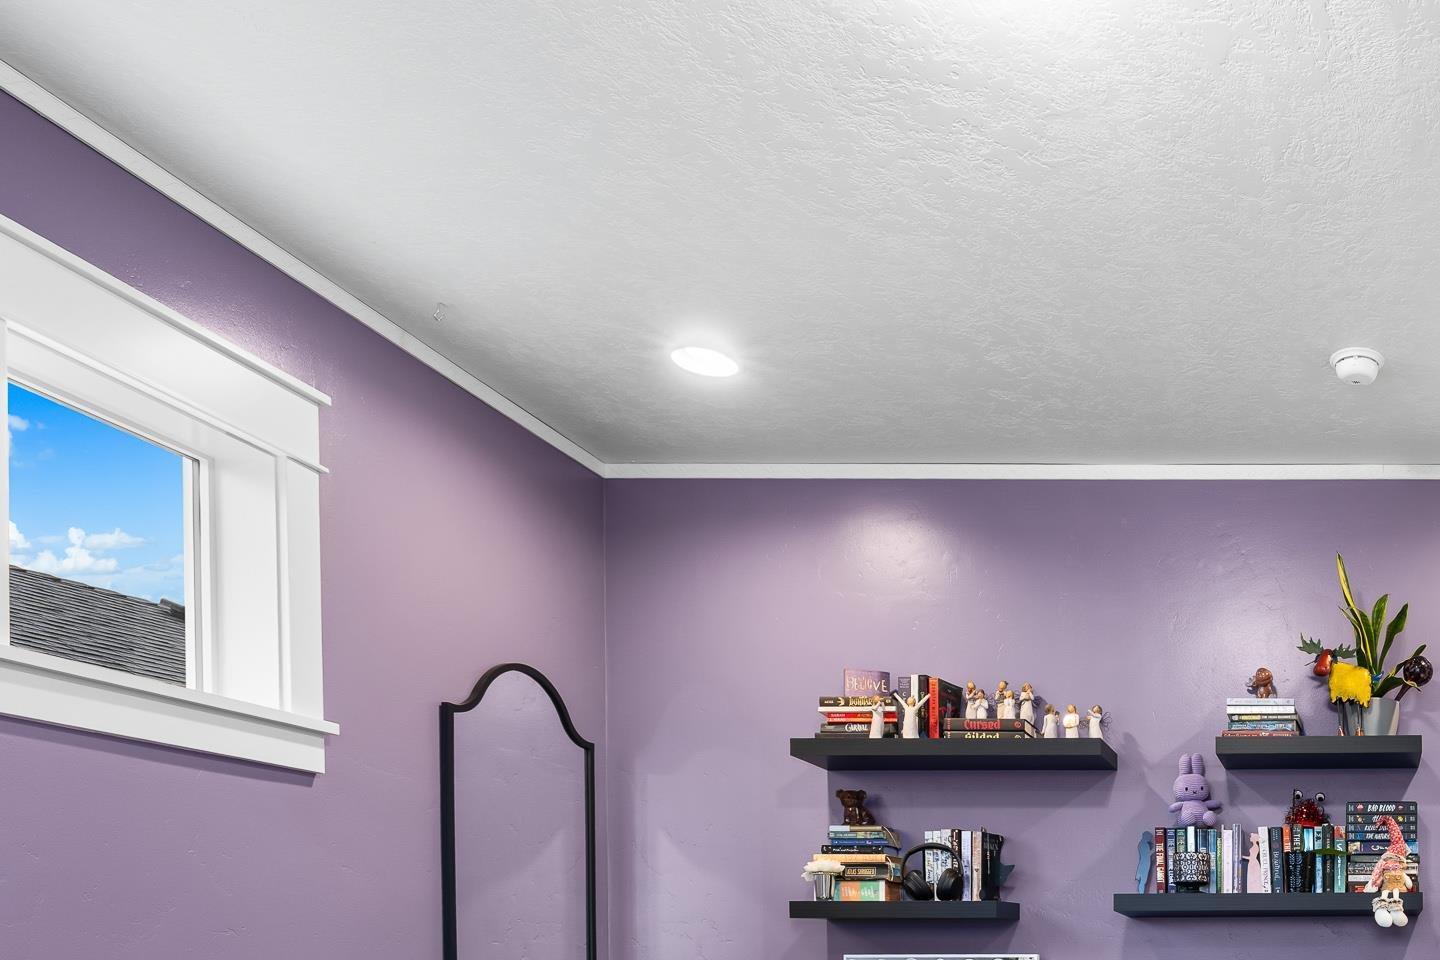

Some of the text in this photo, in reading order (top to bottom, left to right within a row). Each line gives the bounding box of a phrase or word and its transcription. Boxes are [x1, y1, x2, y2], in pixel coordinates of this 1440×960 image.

[964, 719, 1000, 730] Cursed
[1367, 804, 1396, 812] BAD BLOOD
